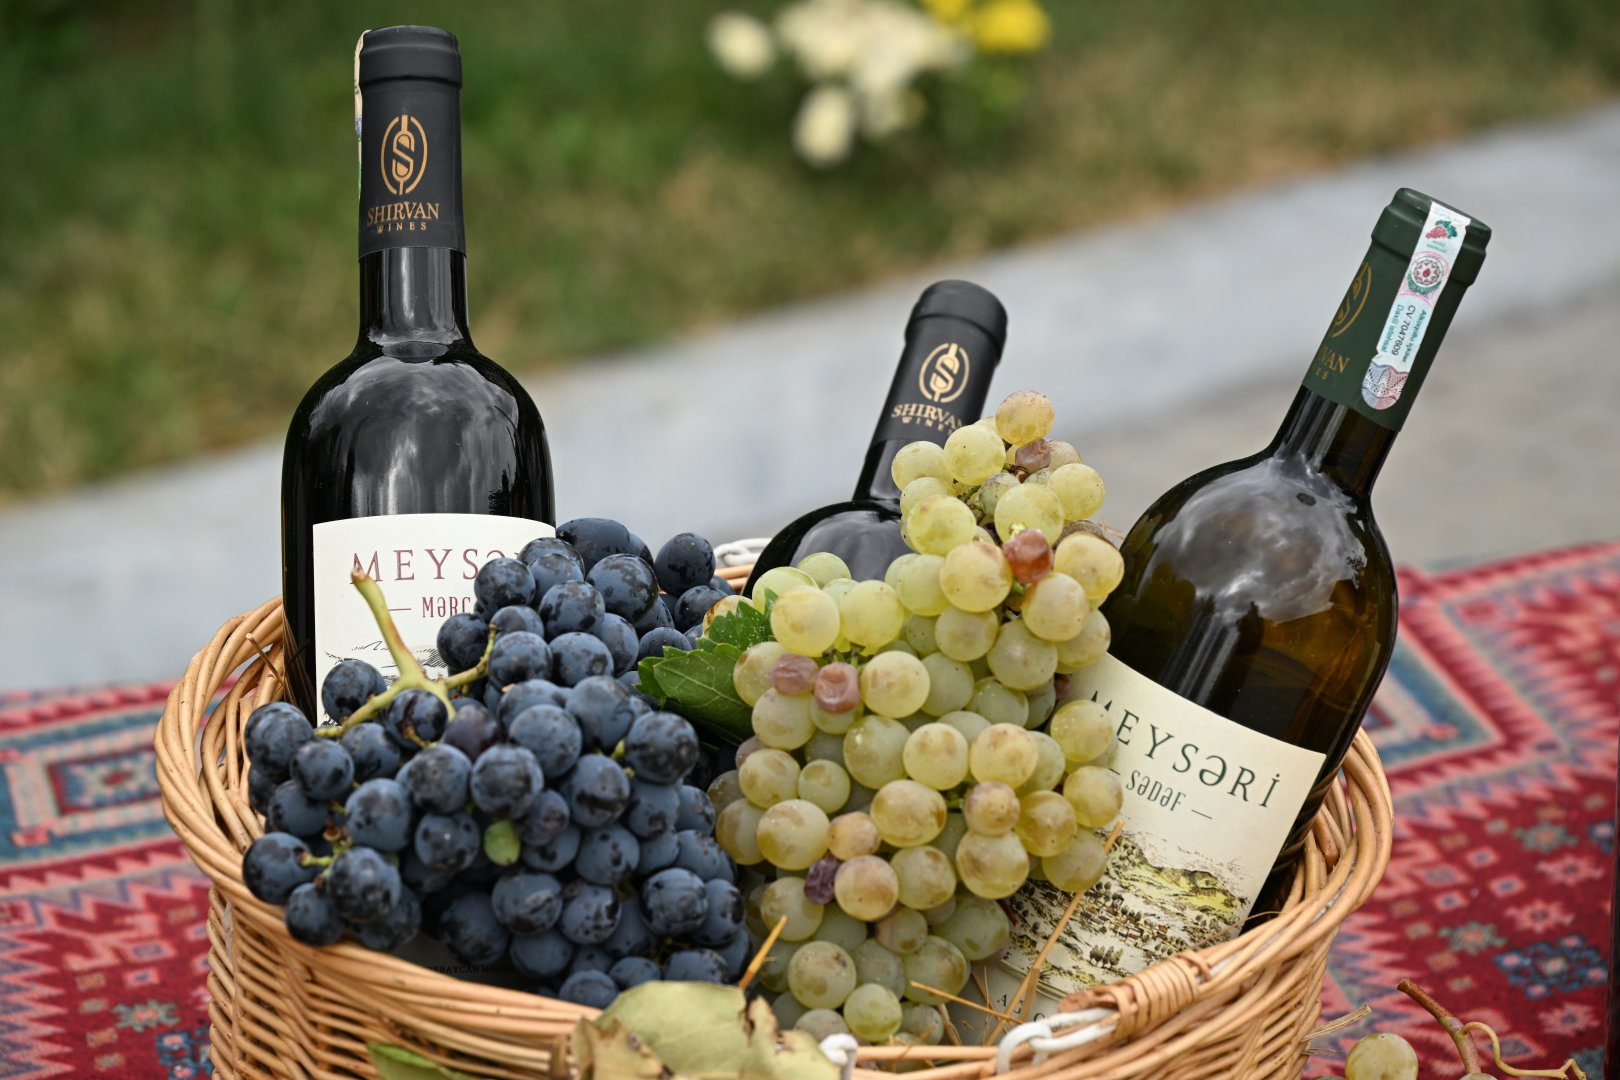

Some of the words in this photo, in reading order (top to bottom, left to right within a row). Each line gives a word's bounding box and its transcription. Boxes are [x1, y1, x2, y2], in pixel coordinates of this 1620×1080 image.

[367, 202, 440, 226] SHIRVAN
[377, 221, 428, 234] WINES
[1405, 305, 1416, 319] CV
[350, 548, 520, 585] MEYS
[1091, 690, 1281, 808] EYSƏRİ
